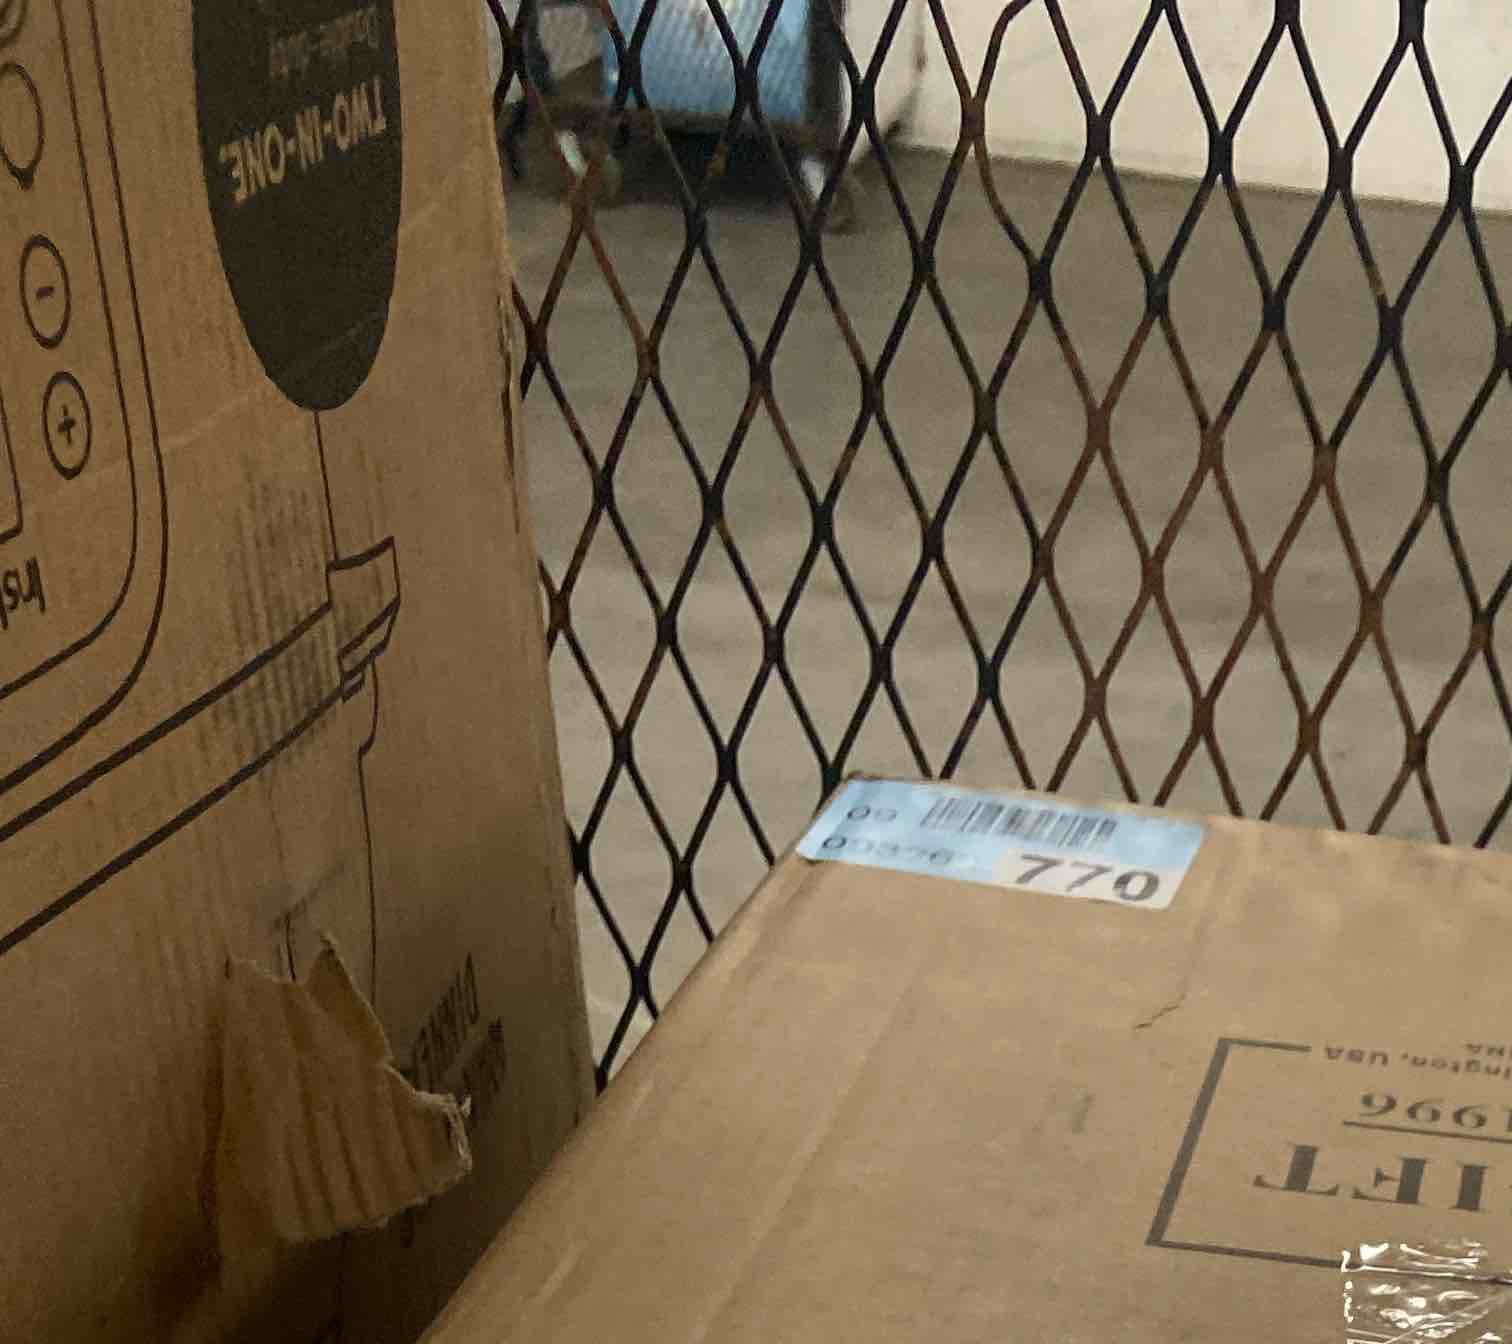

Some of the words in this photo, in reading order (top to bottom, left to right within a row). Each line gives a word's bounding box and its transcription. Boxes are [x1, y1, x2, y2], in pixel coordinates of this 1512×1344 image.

[218, 74, 387, 206] TWO-IN-ONE
[1015, 853, 1161, 902] 770
[1323, 1046, 1389, 1067] USA
